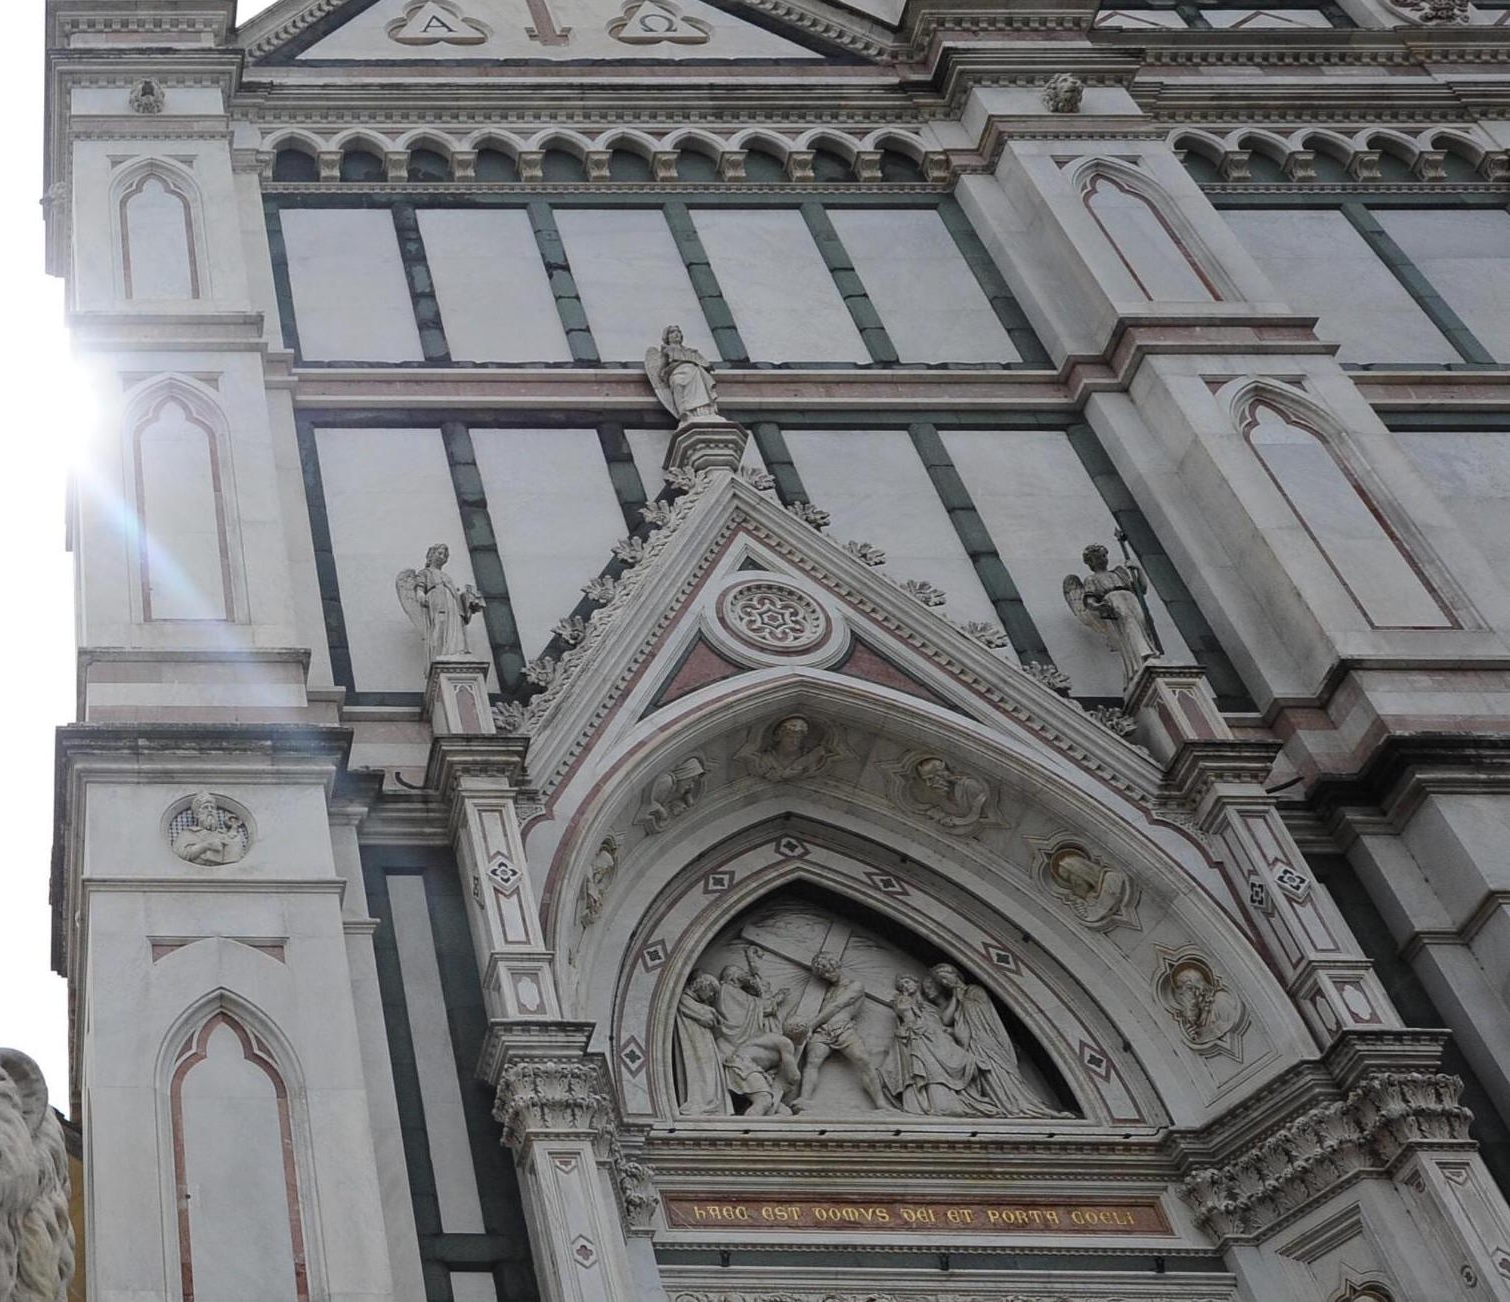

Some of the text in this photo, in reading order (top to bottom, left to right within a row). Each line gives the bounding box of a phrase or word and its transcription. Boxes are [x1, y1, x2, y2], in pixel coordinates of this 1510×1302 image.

[422, 15, 458, 33] A
[639, 14, 678, 33] Ω
[761, 1205, 801, 1222] EST
[900, 1207, 937, 1223] DEI
[946, 1208, 974, 1224] ET
[988, 1209, 1060, 1225] PORTA
